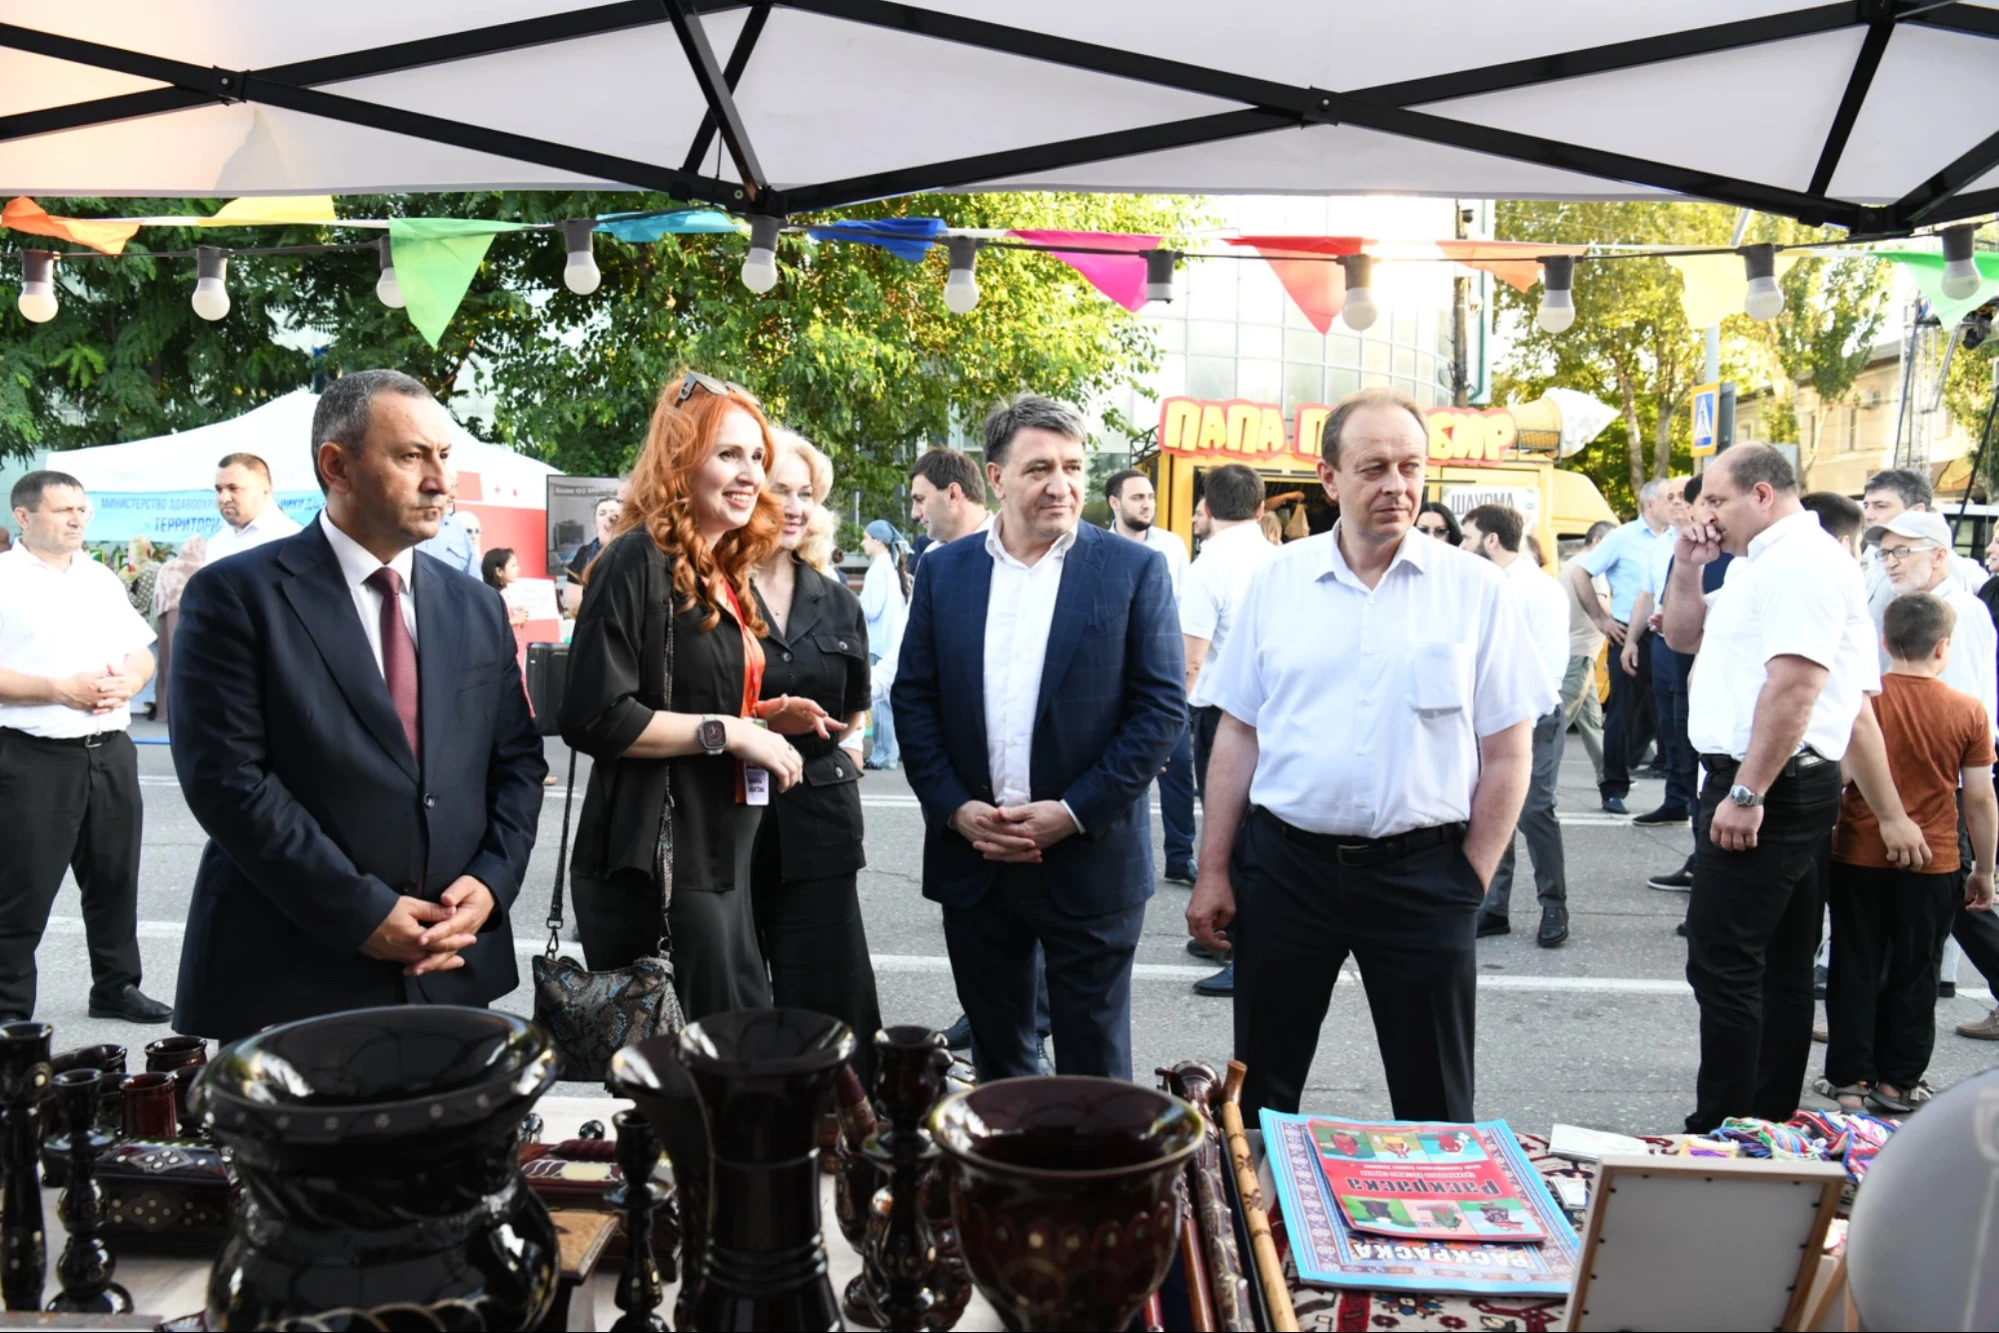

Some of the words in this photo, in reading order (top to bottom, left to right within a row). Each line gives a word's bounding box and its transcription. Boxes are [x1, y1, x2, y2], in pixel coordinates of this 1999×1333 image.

[1163, 400, 1285, 454] ПАПА
[1299, 402, 1515, 461] ПБИР
[101, 496, 167, 510] МИНИСТЕРСТВО
[155, 516, 220, 532] ТЕРРИТОРИ
[1347, 1178, 1500, 1195] Раскраска
[1352, 1243, 1530, 1268] РАСКРАСКА
